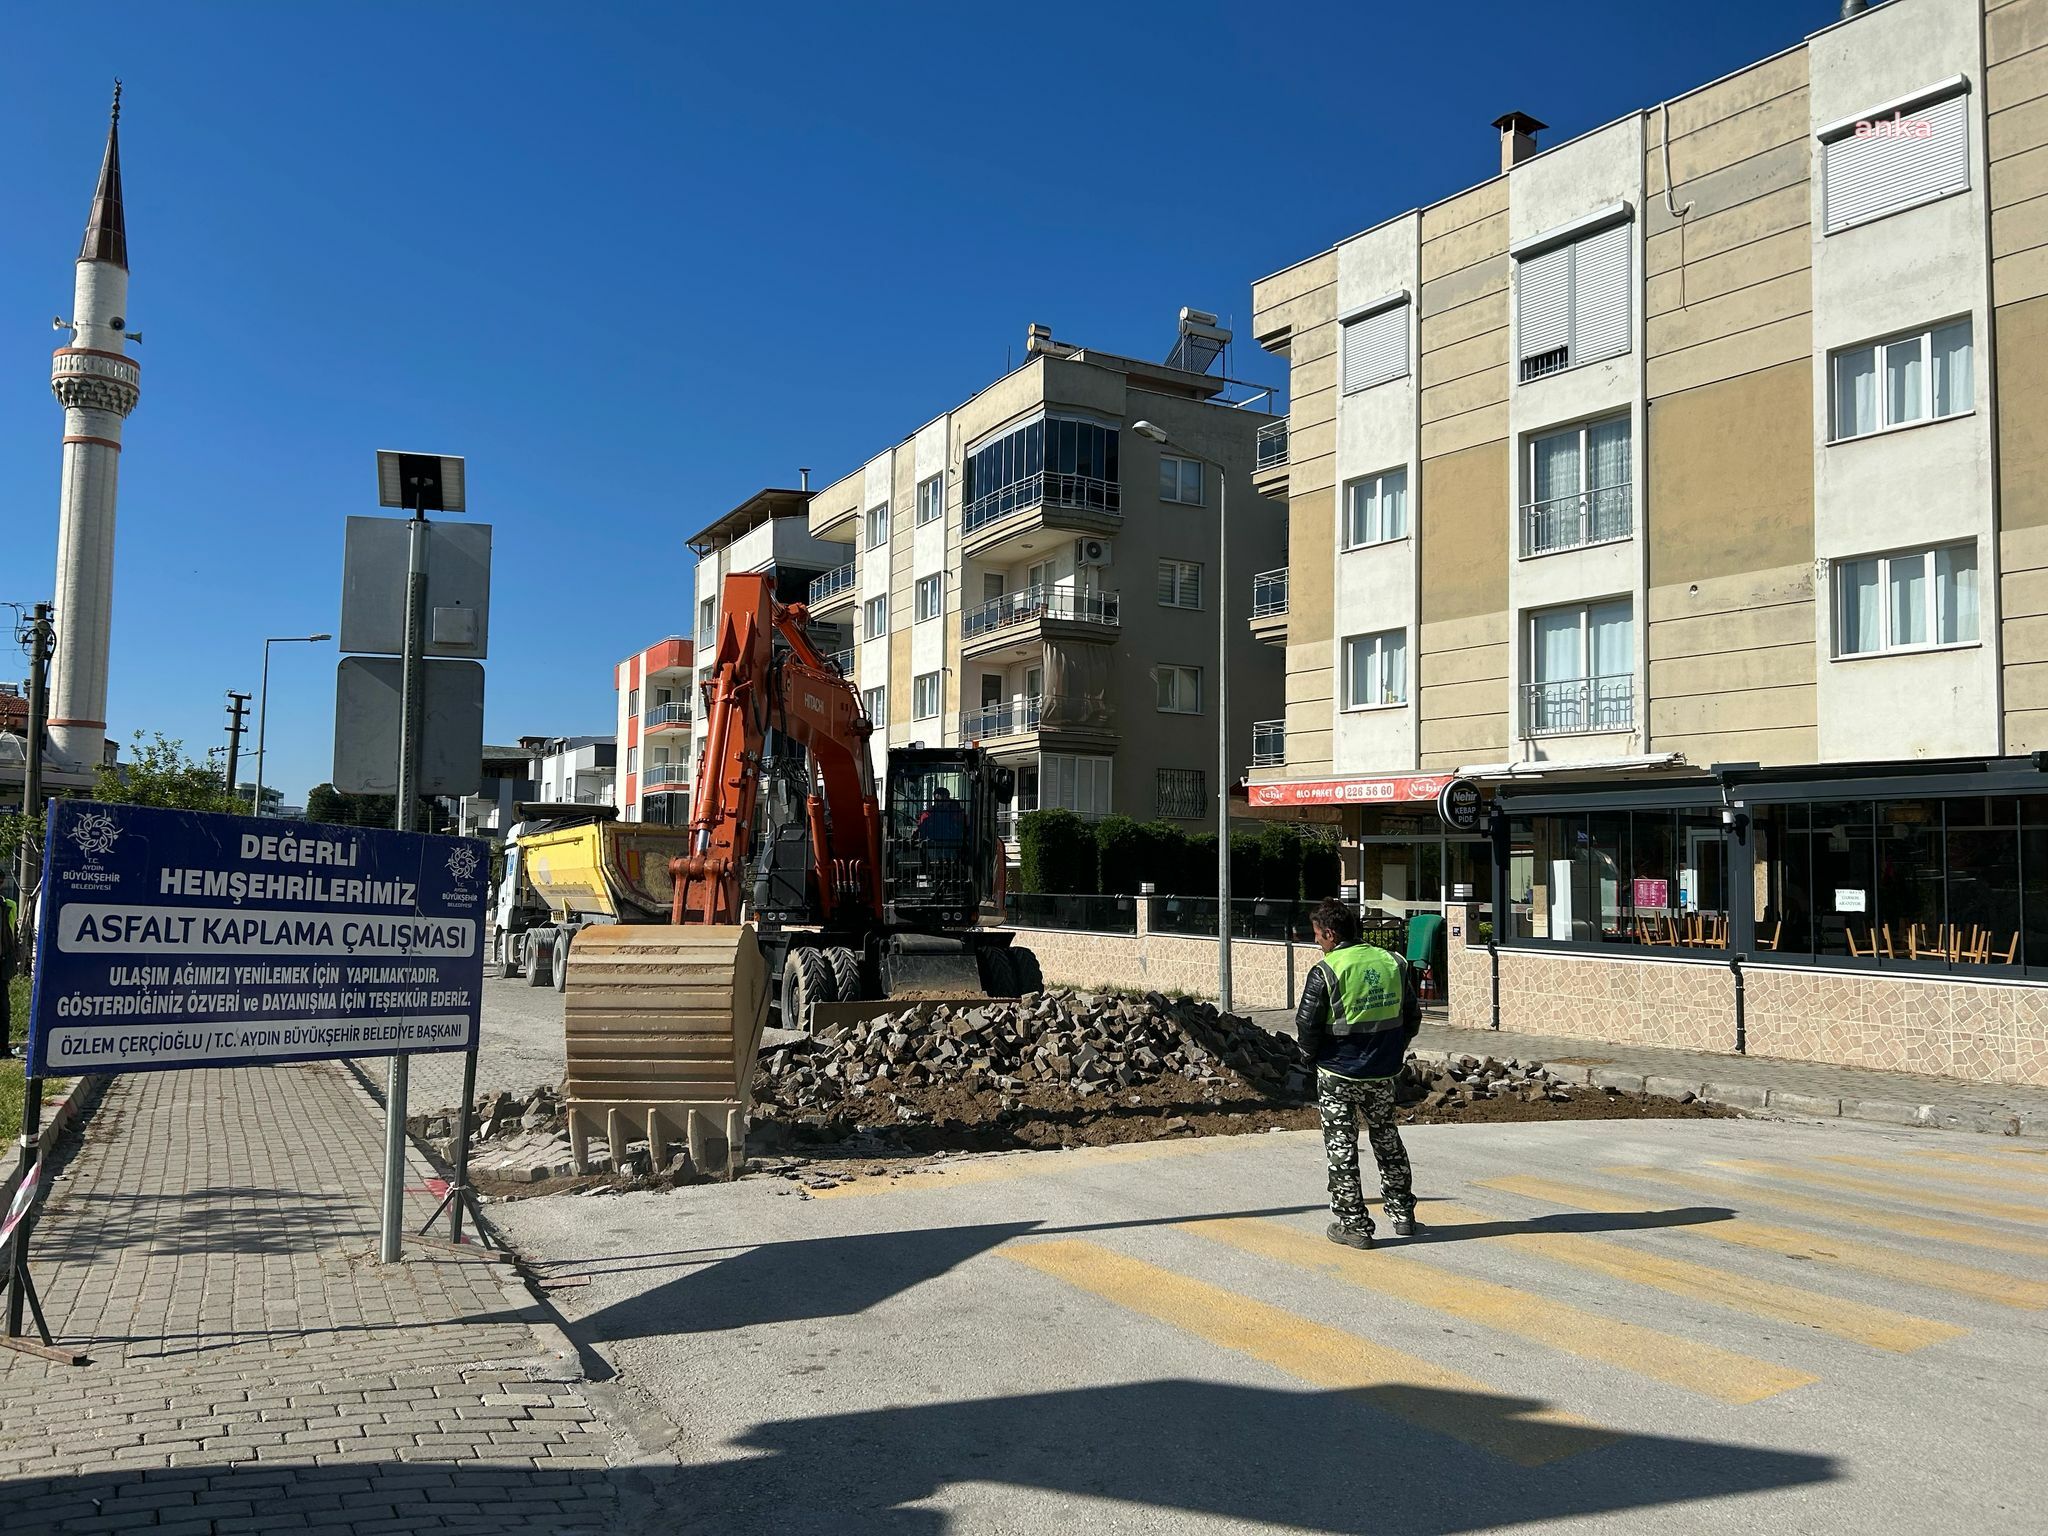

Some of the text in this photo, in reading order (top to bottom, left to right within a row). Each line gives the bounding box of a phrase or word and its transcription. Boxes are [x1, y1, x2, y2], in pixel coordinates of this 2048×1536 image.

[1296, 789, 1311, 799] ALO
[1311, 788, 1333, 799] PAKET
[1346, 786, 1364, 797] 226
[1380, 785, 1393, 796] 60
[1452, 791, 1478, 802] Nehir
[1454, 806, 1477, 815] KEBAP
[1458, 814, 1474, 823] PİDE
[241, 829, 357, 867] DEĞERLİ
[81, 864, 104, 872] AYDIN
[62, 869, 120, 884] BÜYÜKŞEHİR
[71, 883, 112, 891] BELEDİYESİ
[160, 867, 416, 906] HEMŞEHRİLERİMİZ
[75, 913, 466, 955] ASFALT KAPLAMA ÇALIŞMASI
[109, 961, 440, 991] ULAŞIM AĞIMIZI YENİLEMEK İÇİN YAPILMAKTADIR.
[57, 986, 471, 1017] GÖSTERDİĞİNİZ ÖZVERİ ve DAYANIŞMA İÇİN TEŞEKKÜR EDERİZ.
[61, 1034, 115, 1056] ÖZLEM
[119, 1030, 203, 1058] ÇERÇİOĞLU
[214, 1032, 237, 1048] T.C.
[240, 1030, 280, 1048] AYDIN
[284, 1024, 360, 1047] BÜYÜKŞEHİR
[363, 1022, 415, 1042] BELEDİYE
[417, 1023, 462, 1042] BAŞKANI
